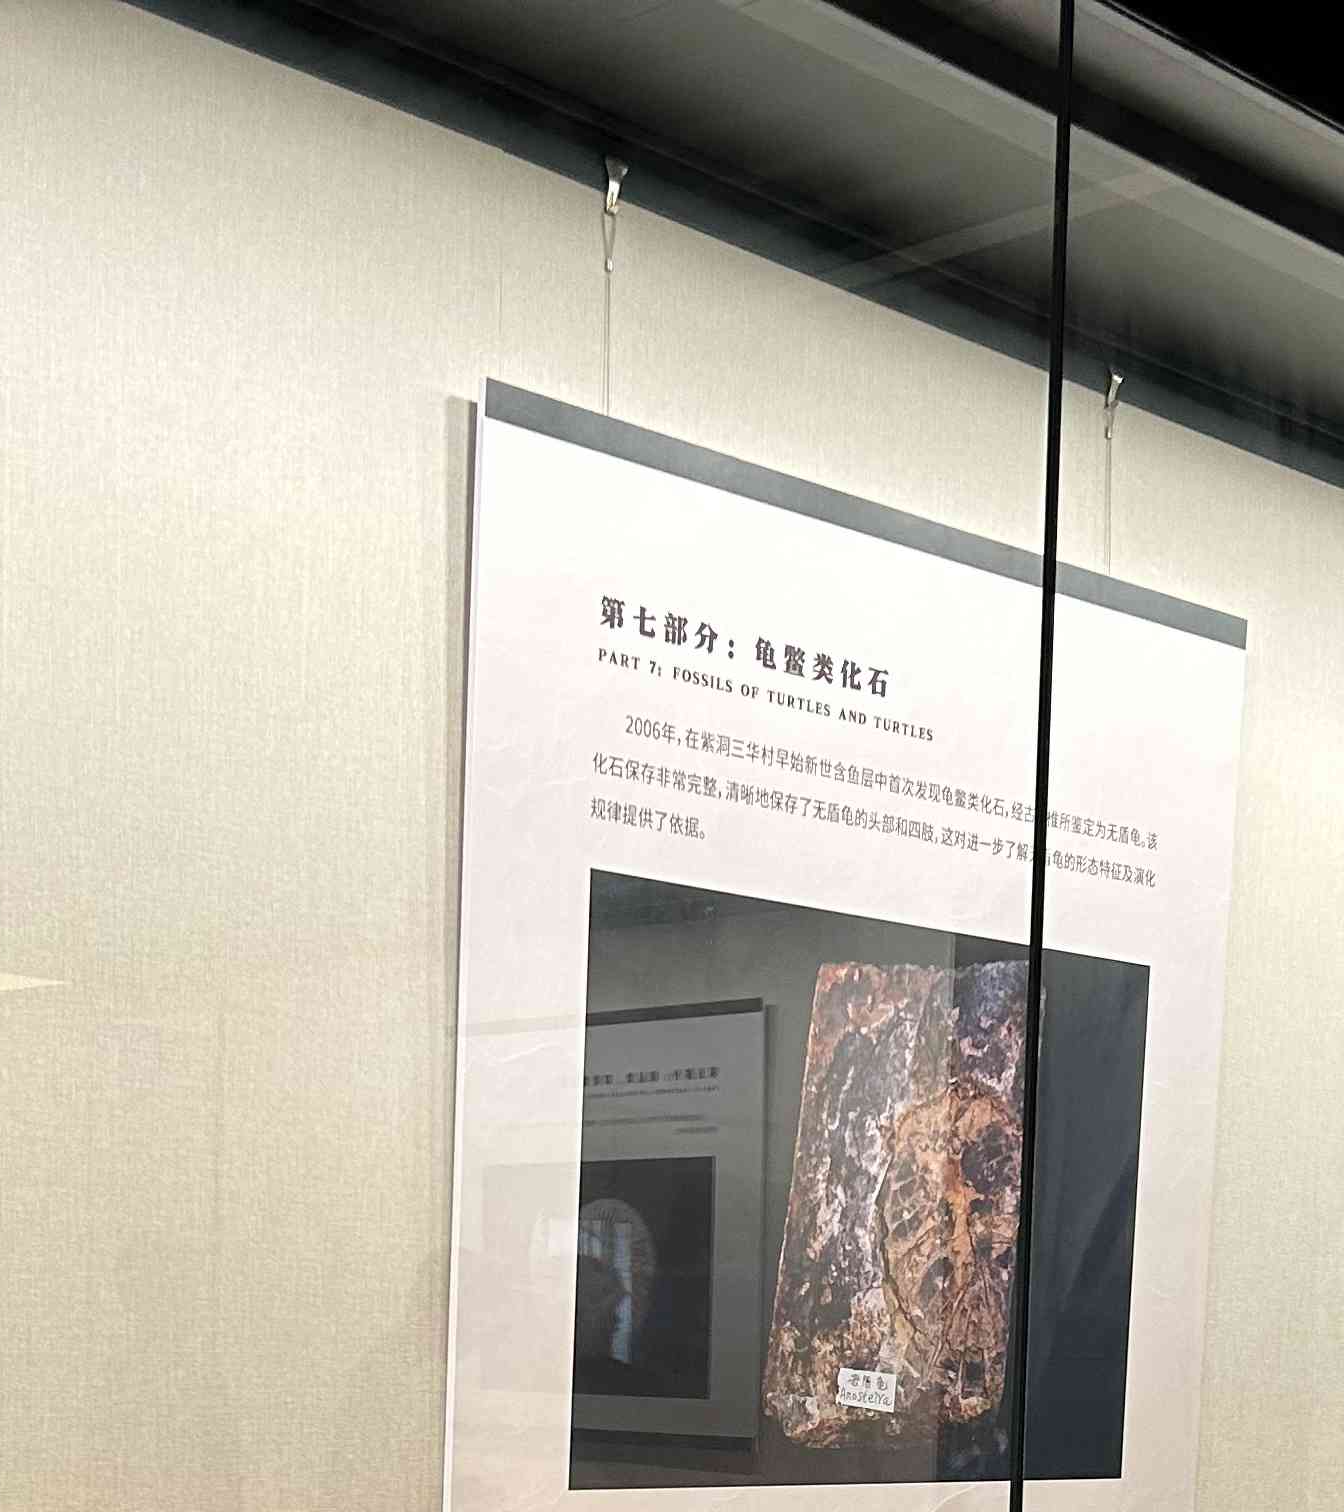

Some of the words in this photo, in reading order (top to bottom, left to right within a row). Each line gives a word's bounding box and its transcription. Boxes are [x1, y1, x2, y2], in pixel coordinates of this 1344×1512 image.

[598, 648, 641, 670] PART
[649, 660, 662, 677] 7:
[673, 667, 734, 693] FOSSILS
[740, 683, 760, 699] OF
[767, 690, 831, 717] TURTLES
[838, 708, 867, 725] AND
[874, 716, 934, 741] TURTLES
